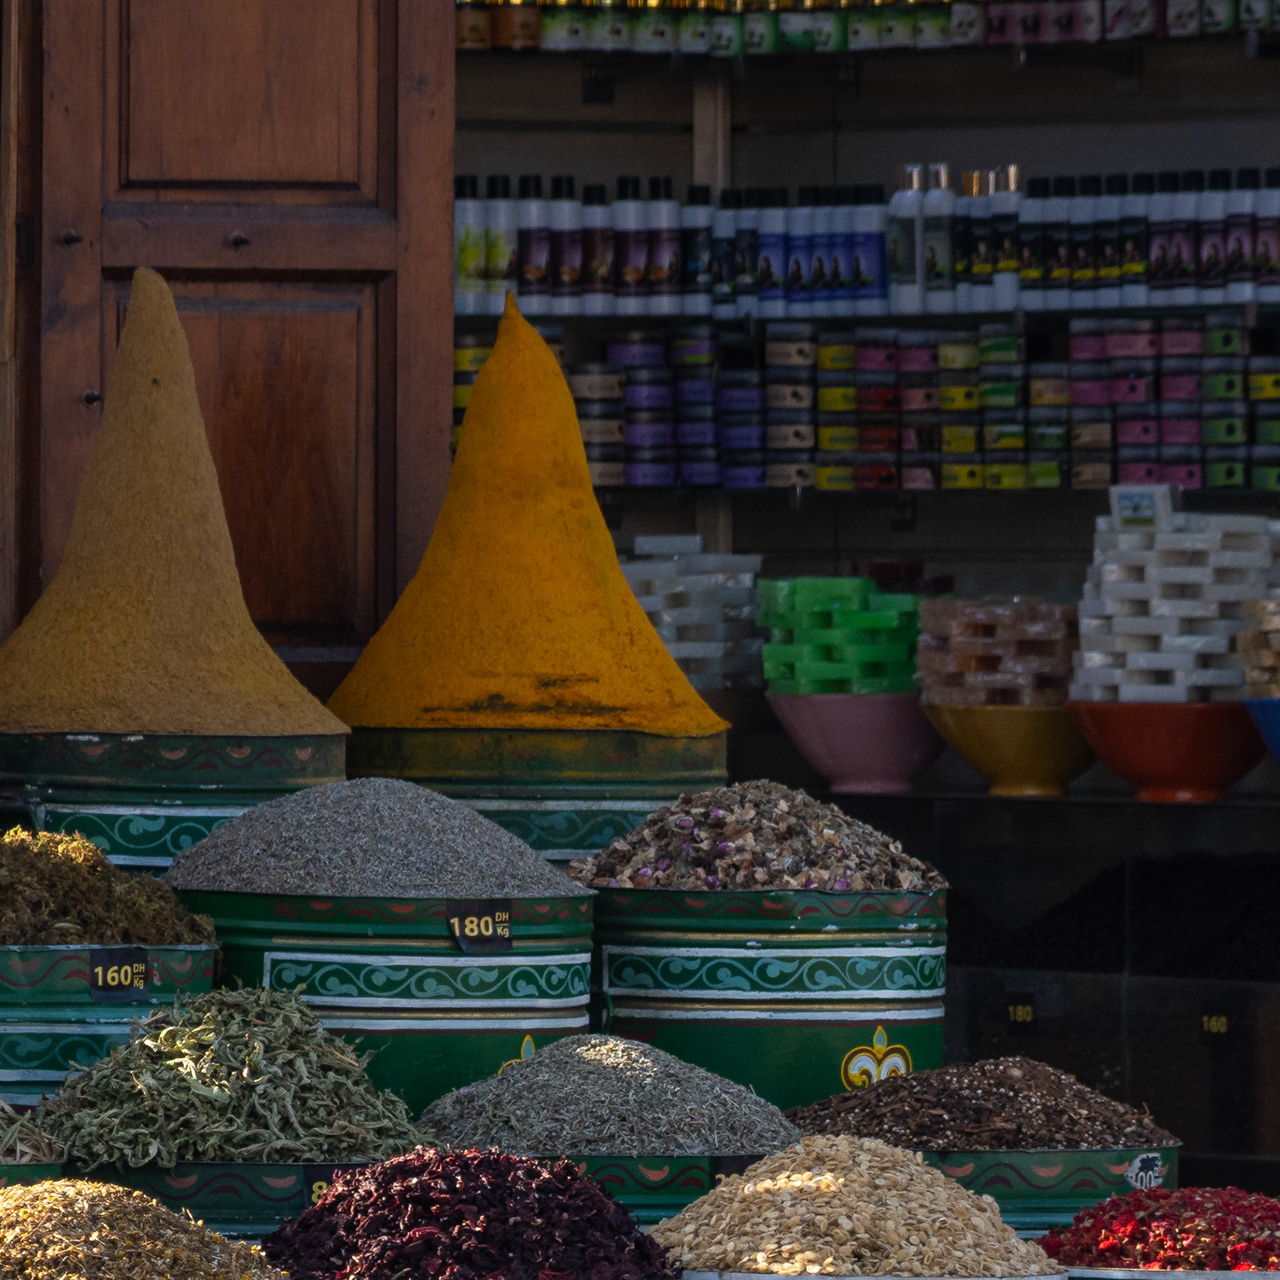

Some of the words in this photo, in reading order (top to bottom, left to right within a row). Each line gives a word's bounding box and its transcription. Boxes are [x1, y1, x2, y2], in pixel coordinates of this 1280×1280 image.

[495, 912, 509, 922] DH
[450, 916, 493, 937] 180
[496, 926, 510, 938] Kg
[132, 963, 146, 974] DH
[94, 965, 132, 987] 160
[133, 977, 145, 990] Kg
